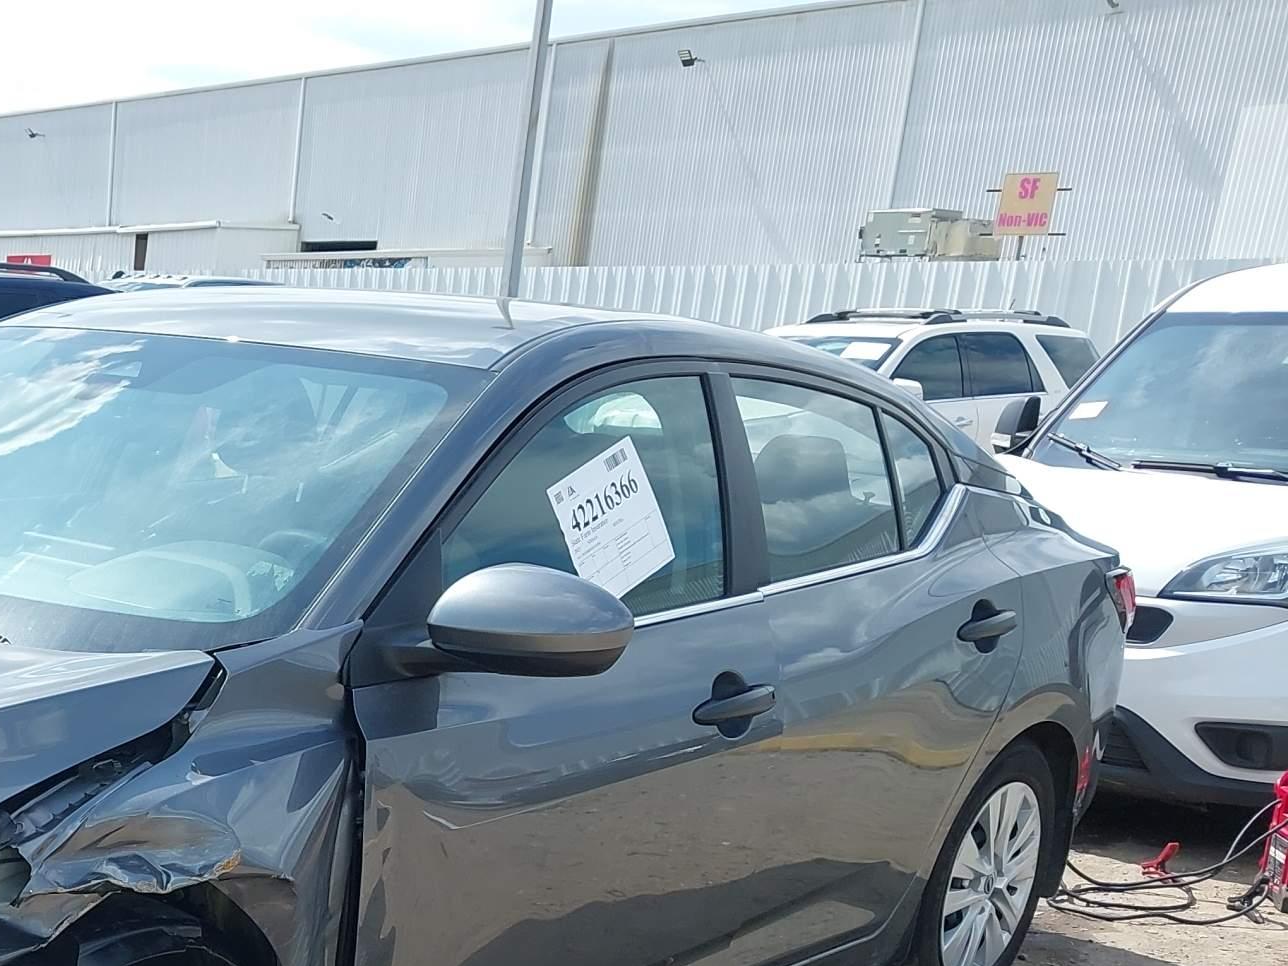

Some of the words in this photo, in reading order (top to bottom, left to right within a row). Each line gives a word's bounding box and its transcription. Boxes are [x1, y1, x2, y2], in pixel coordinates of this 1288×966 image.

[1019, 178, 1040, 199] SF
[999, 213, 1047, 226] Non-VIC
[571, 469, 639, 532] 42216366
